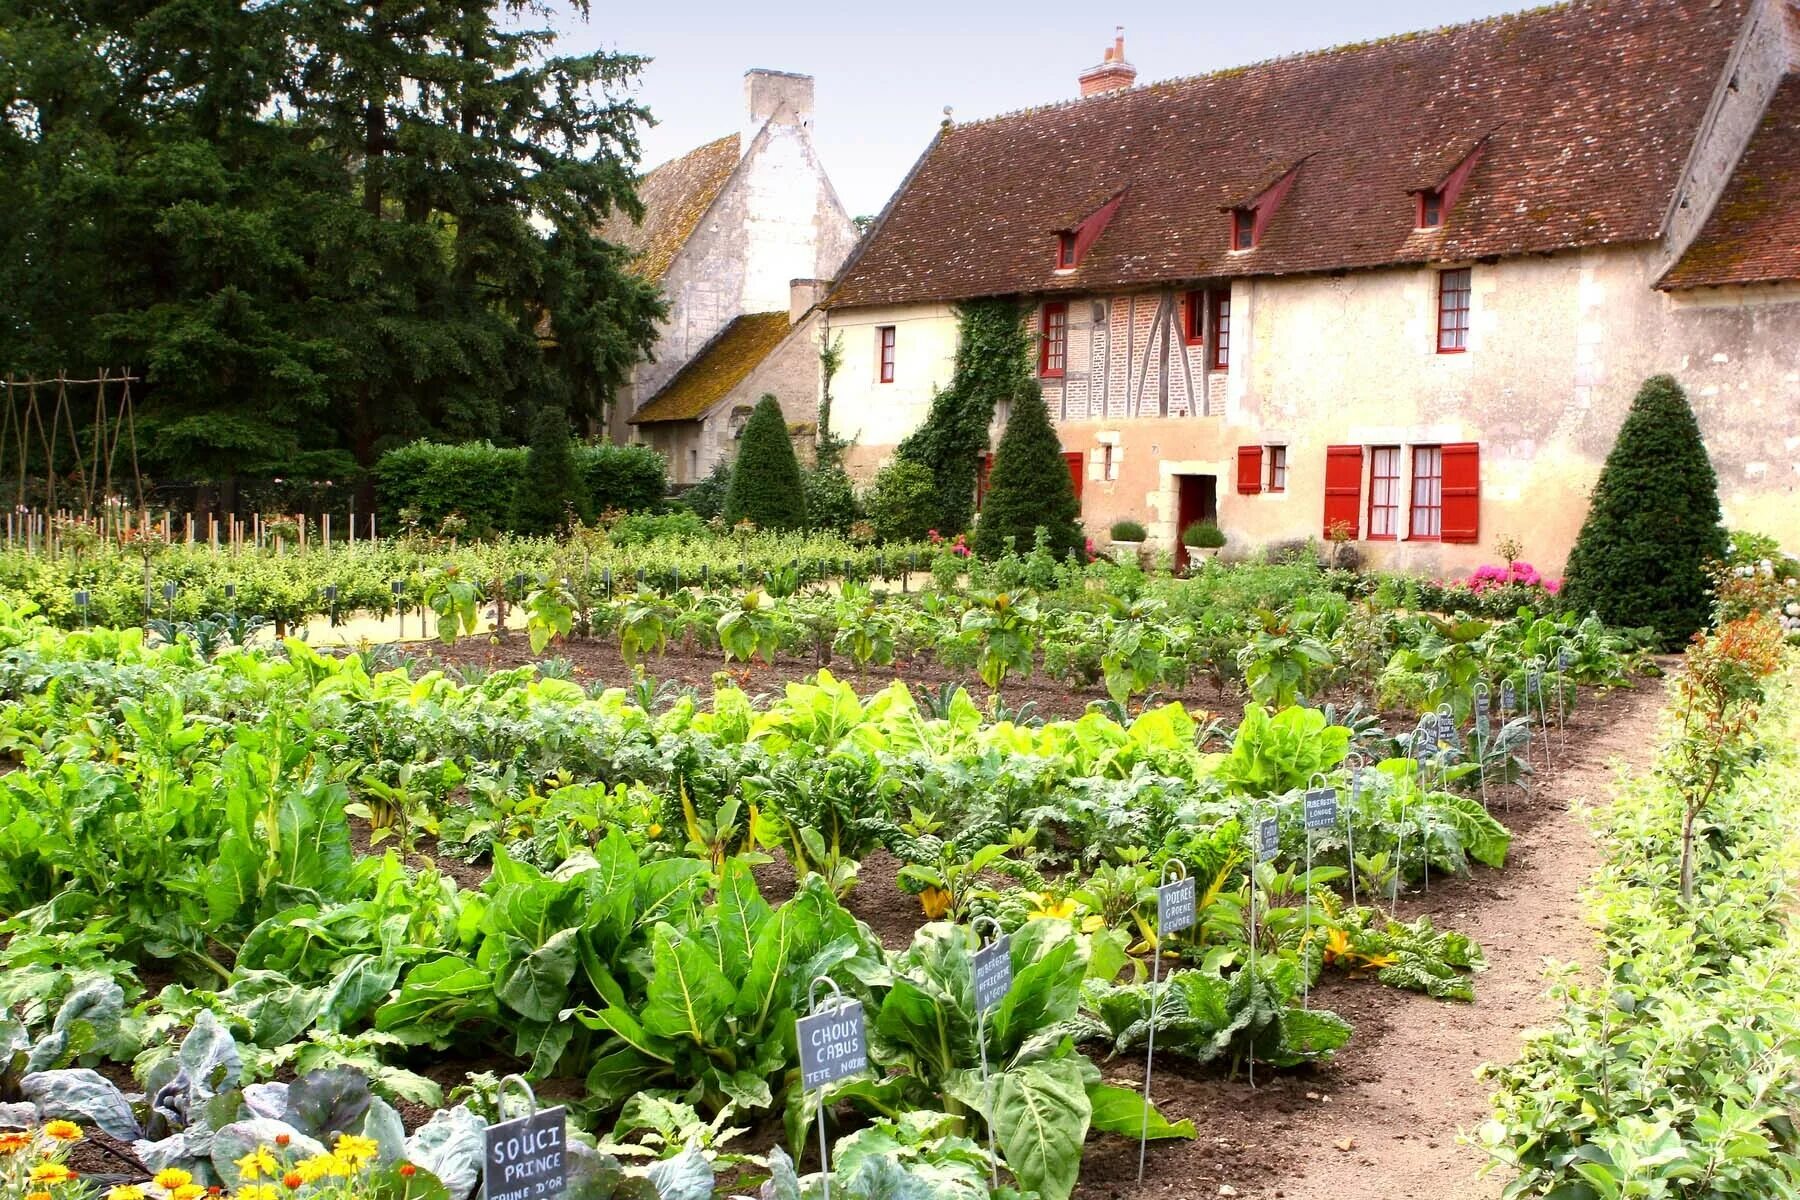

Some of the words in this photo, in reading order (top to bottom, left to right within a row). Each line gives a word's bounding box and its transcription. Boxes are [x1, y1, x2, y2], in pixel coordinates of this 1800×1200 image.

[1307, 818, 1335, 827] VIOLETTE
[1310, 808, 1332, 818] LONGUE
[1165, 903, 1192, 919] GROENE
[811, 1018, 858, 1046] CHOUX
[816, 1038, 859, 1063] CABUS
[805, 1067, 832, 1084] TETE
[840, 1057, 866, 1074] NOIRE
[494, 1126, 561, 1165] SOUCI
[504, 1152, 561, 1183] PRINCE
[535, 1176, 563, 1195] D'OR
